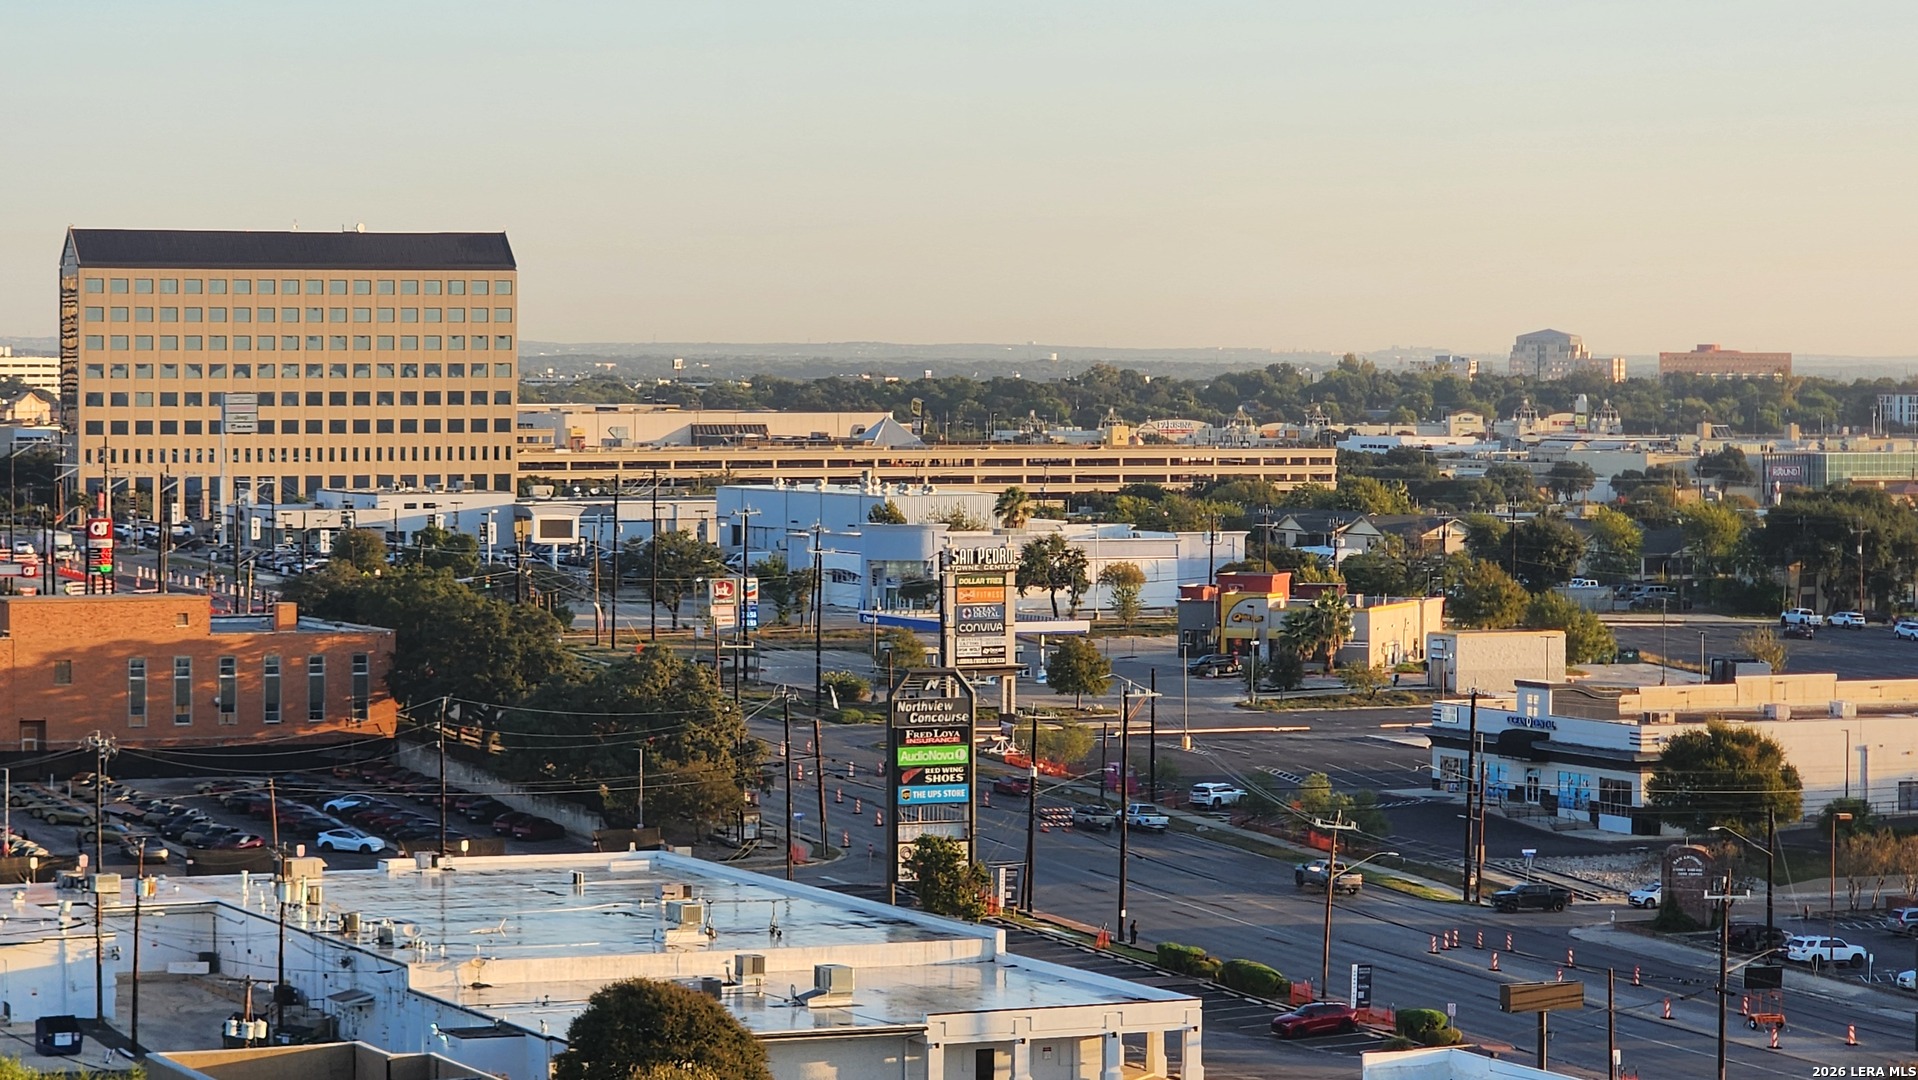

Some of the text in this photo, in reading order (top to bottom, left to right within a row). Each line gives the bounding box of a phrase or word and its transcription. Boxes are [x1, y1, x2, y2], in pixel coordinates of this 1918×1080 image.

[90, 521, 109, 536] QT
[952, 547, 1014, 565] SAN PEDRO
[23, 566, 35, 576] QT
[958, 577, 1004, 585] DOLLAR TREE
[973, 610, 1001, 618] DENTAL
[897, 700, 954, 713] Northview
[909, 712, 970, 724] Concourse
[905, 729, 960, 738] FRED LOYA
[901, 750, 955, 761] AudioNova
[941, 766, 965, 774] WING
[924, 774, 965, 783] SHOES
[912, 788, 966, 799] THE UPS STORE
